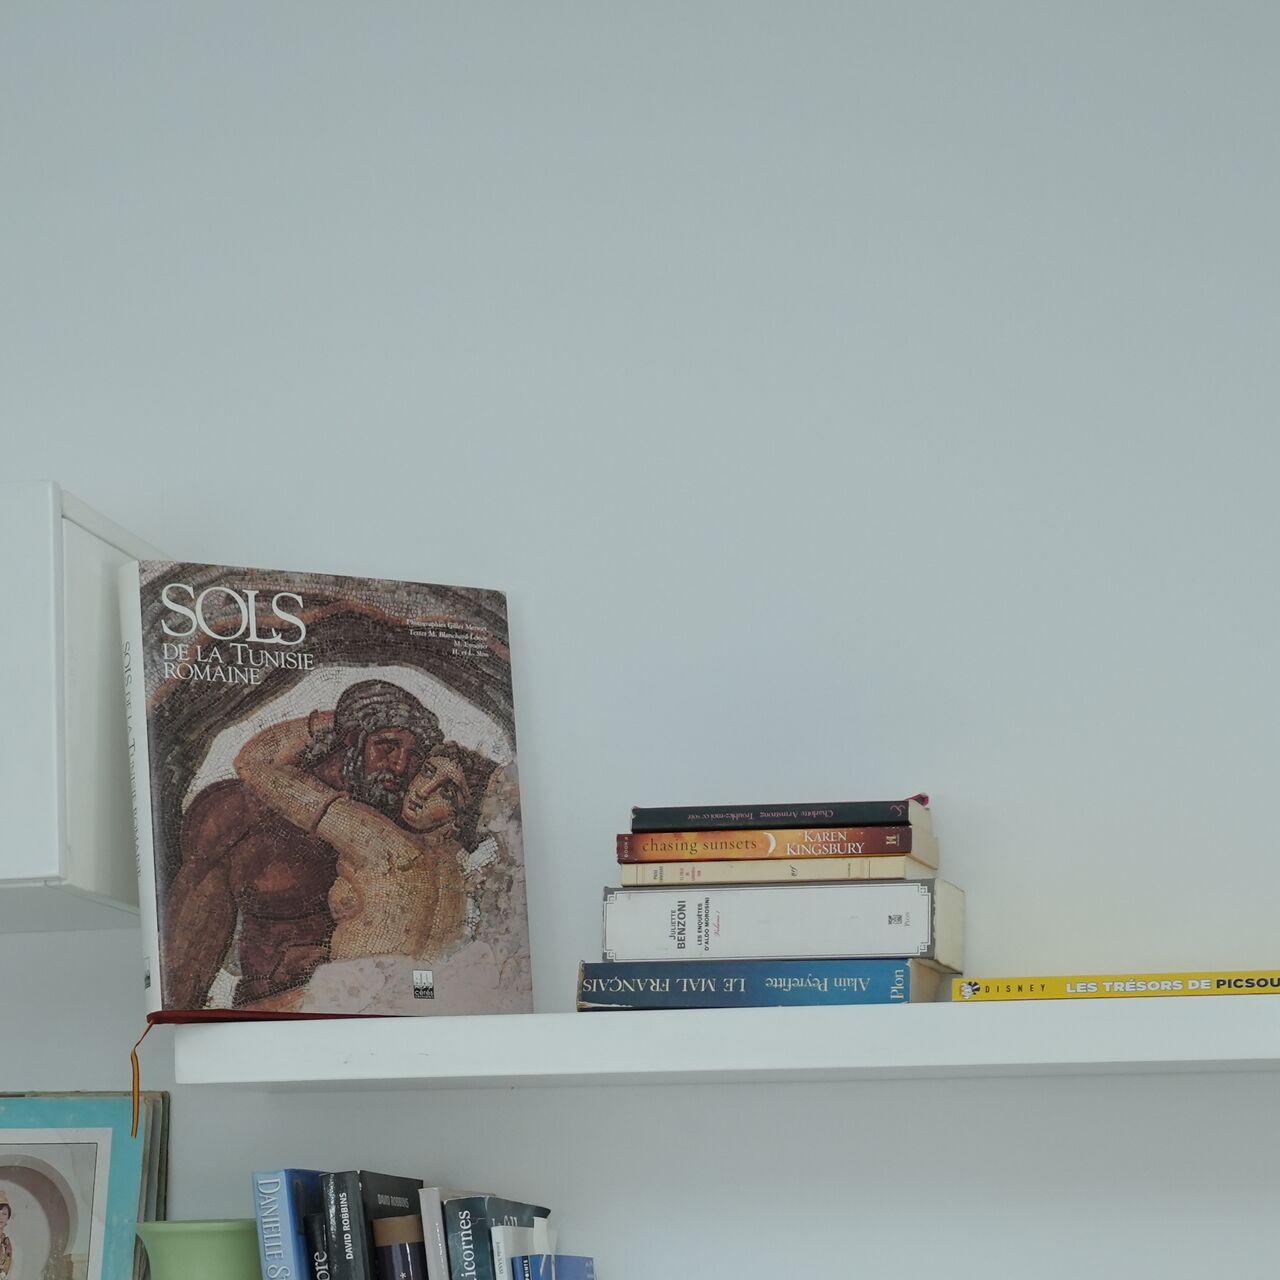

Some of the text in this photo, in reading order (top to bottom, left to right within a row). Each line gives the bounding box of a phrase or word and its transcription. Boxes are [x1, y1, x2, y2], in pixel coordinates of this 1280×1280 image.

[161, 583, 306, 645] SOLS
[163, 642, 315, 671] DE LA TUNISIE
[164, 662, 262, 685] ROMAINE
[642, 837, 757, 855] chasing sunsets
[787, 842, 865, 855] KINGSBURY
[804, 831, 847, 842] KAREN
[677, 900, 686, 949] BENZONI
[582, 973, 870, 992] Alain Peyrefitte LE MAL FRANÇAIS
[890, 969, 904, 999] Plon
[985, 977, 1280, 993] DISNEY LES TRÉSORS DE PICSOU
[257, 1178, 284, 1262] DANIELLE
[339, 1192, 354, 1260] DAVID ROBBINS
